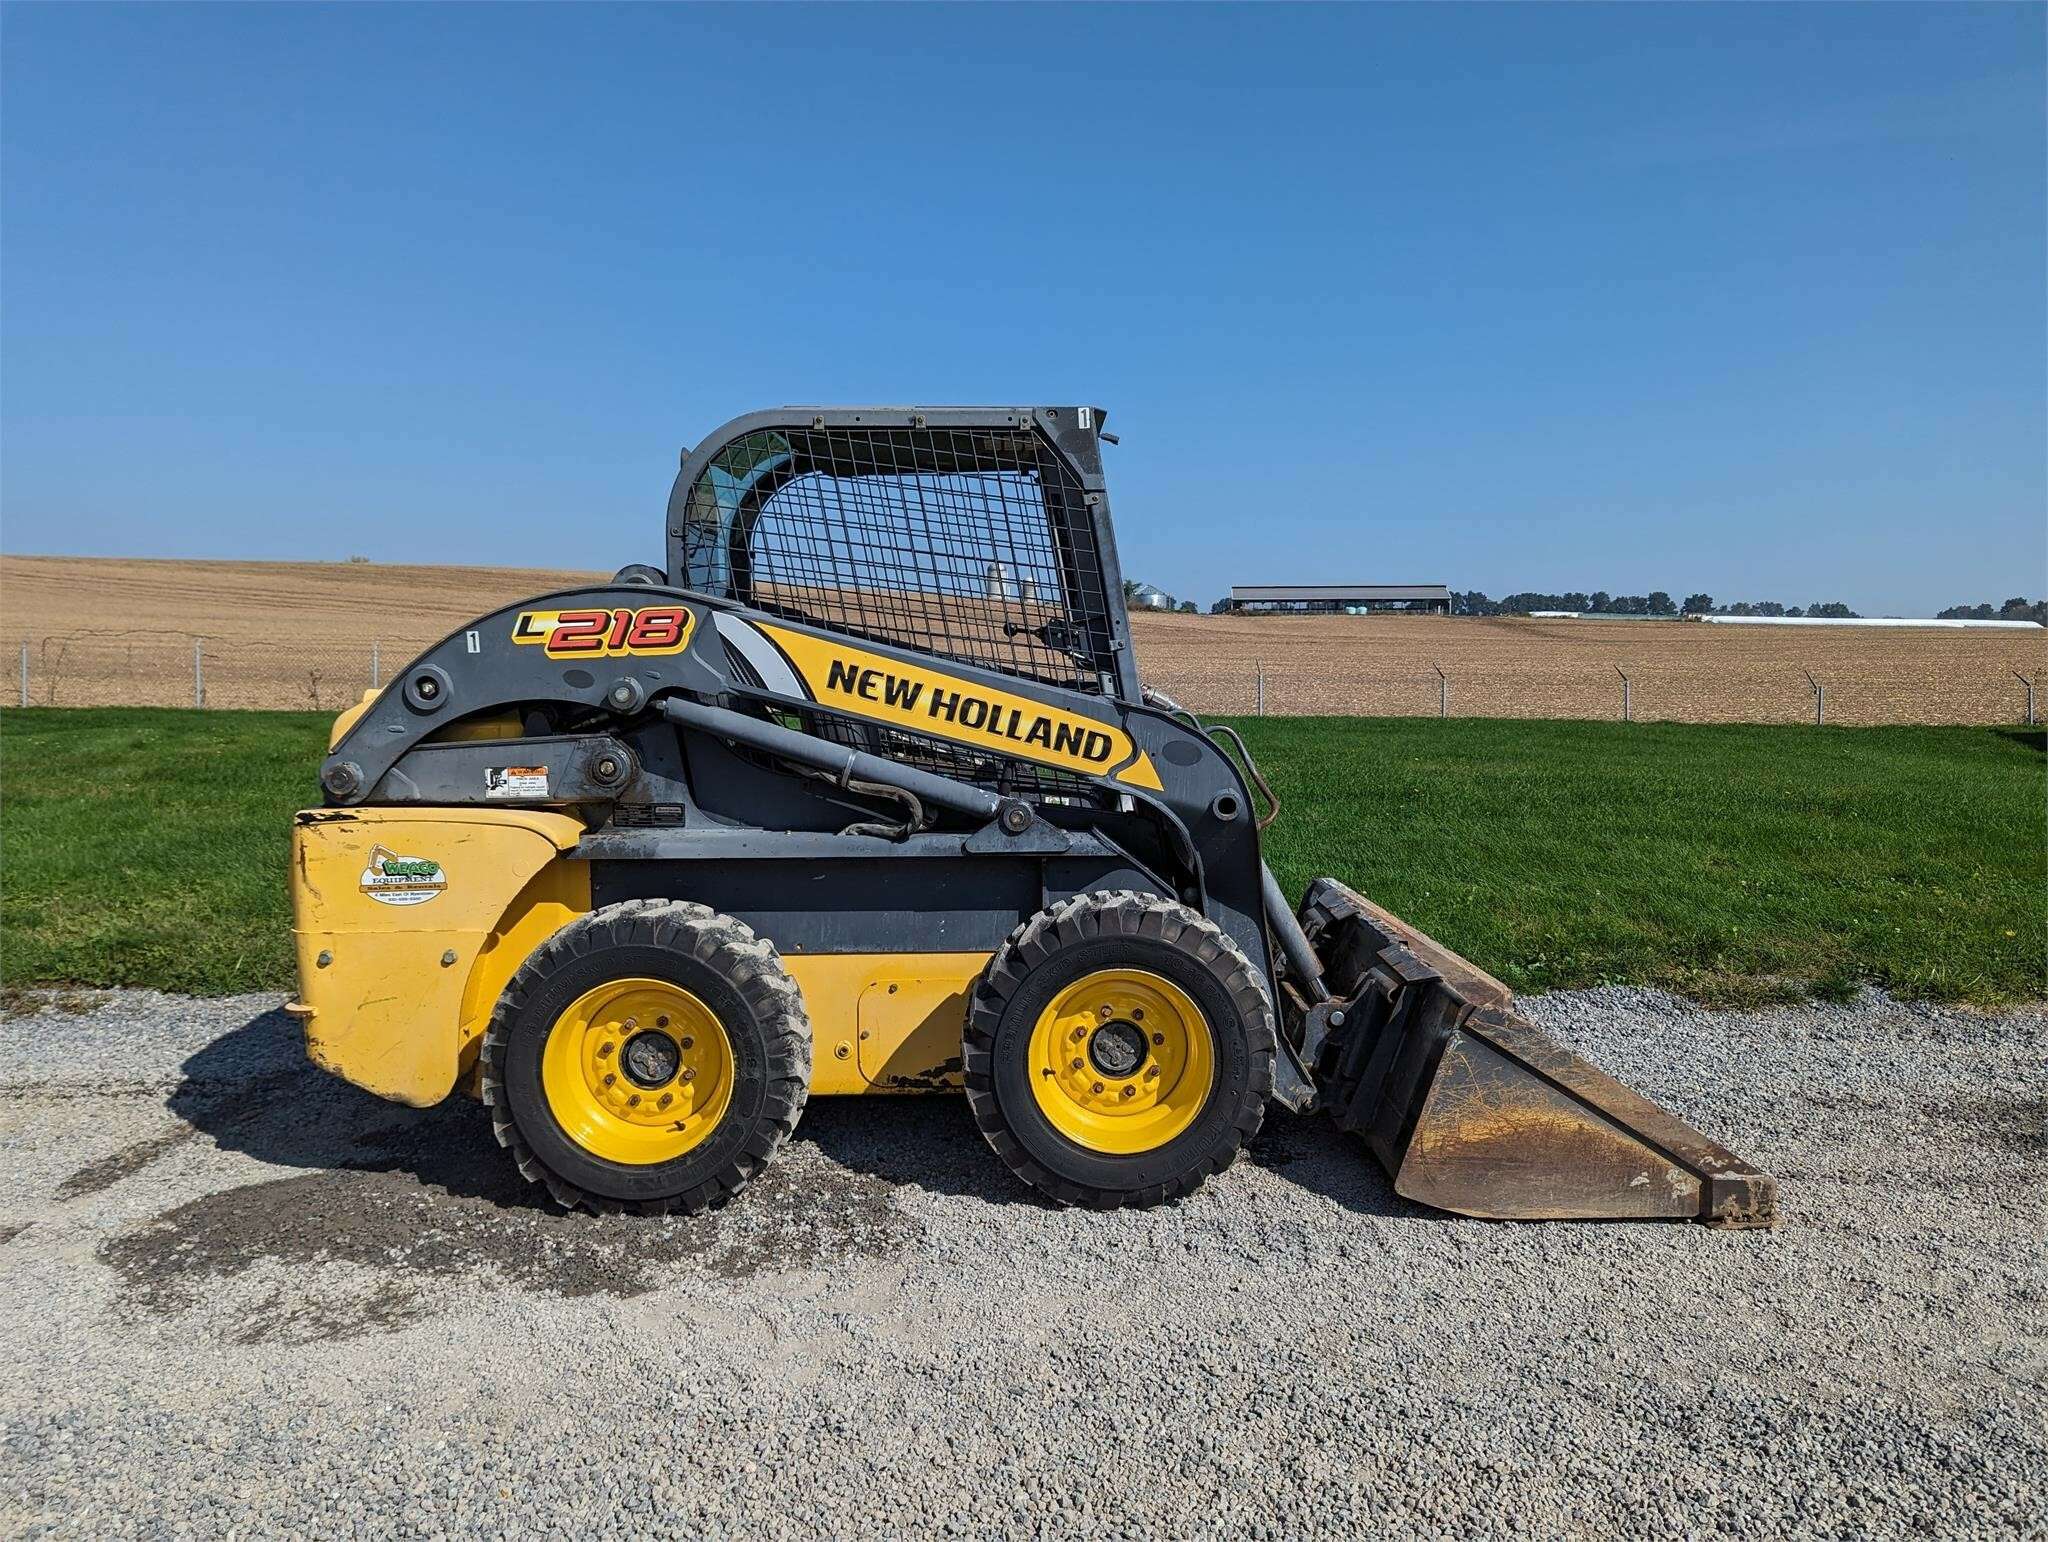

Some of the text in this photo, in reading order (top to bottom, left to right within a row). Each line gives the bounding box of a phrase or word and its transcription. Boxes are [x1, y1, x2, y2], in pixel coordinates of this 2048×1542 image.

[468, 632, 479, 653] 1
[826, 660, 1113, 762] NEW HOLLAND
[373, 876, 433, 885] EQUIPMENT
